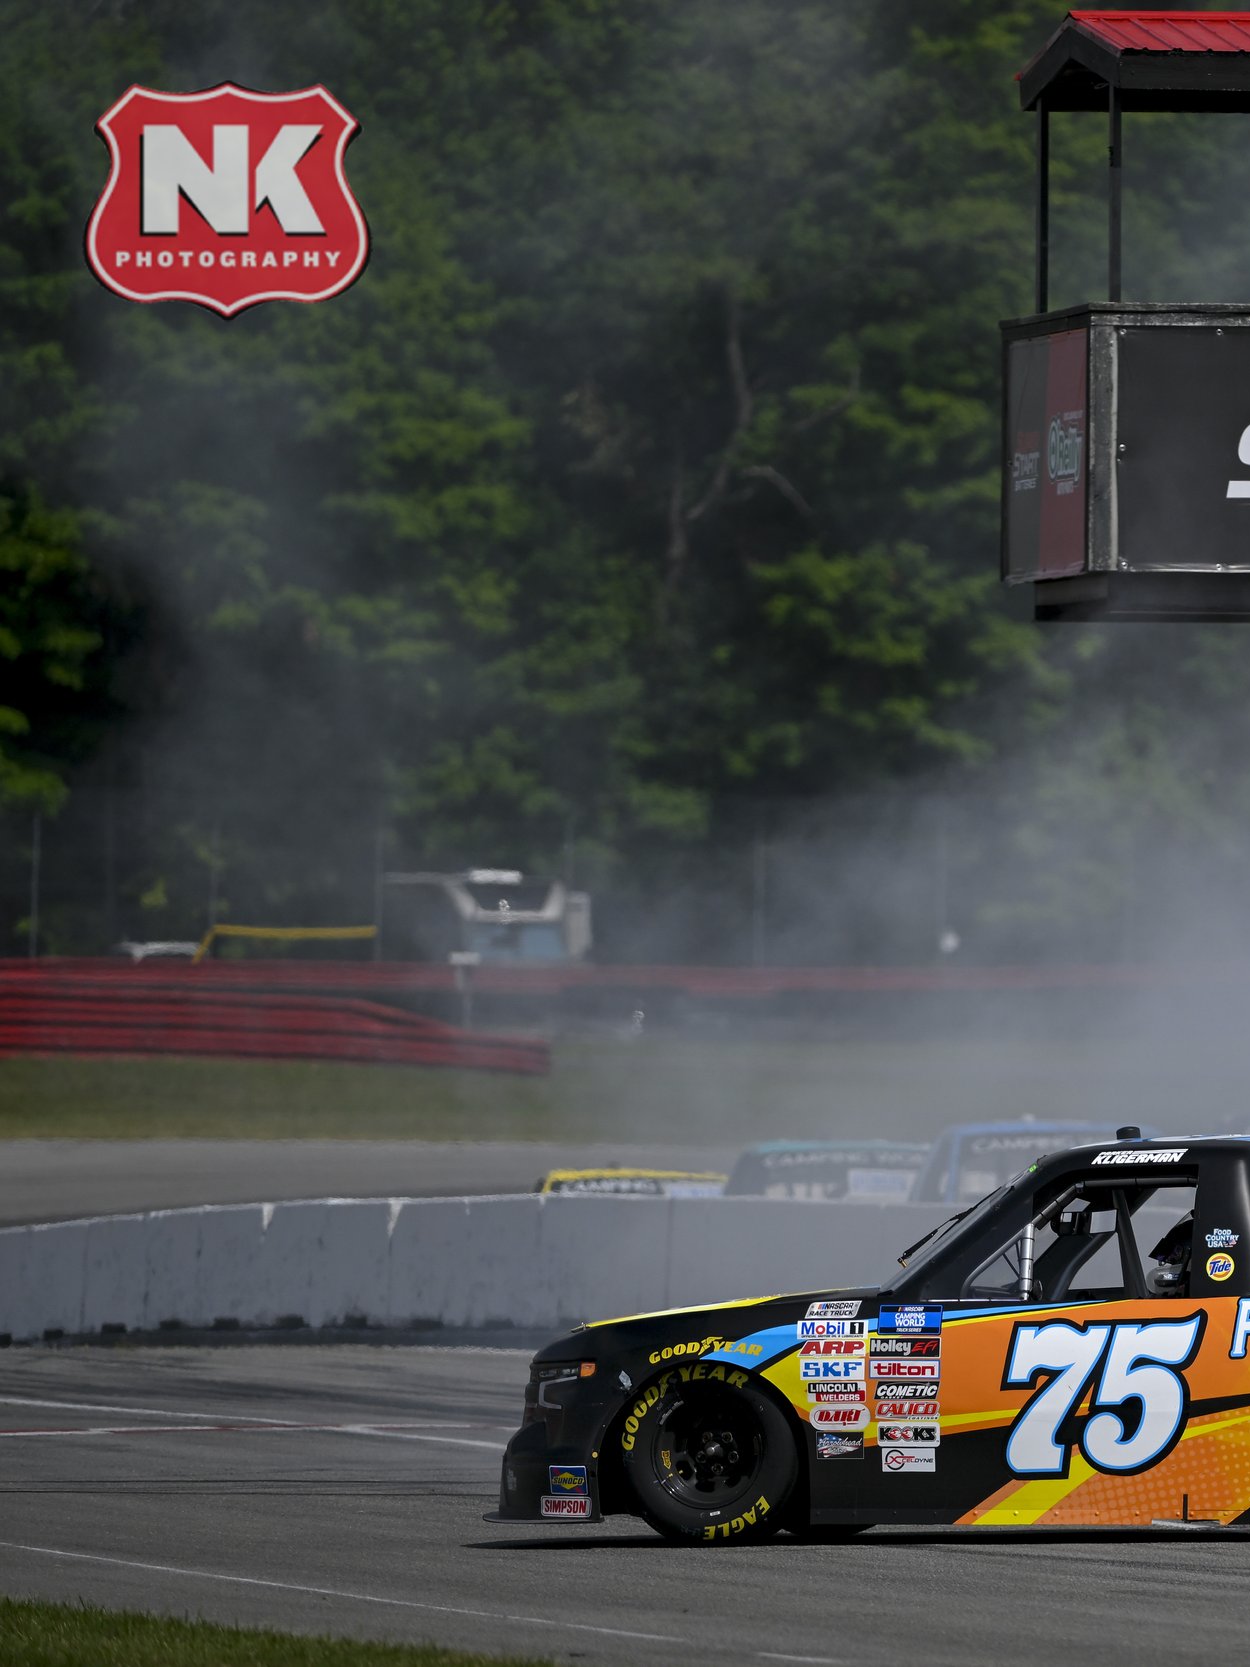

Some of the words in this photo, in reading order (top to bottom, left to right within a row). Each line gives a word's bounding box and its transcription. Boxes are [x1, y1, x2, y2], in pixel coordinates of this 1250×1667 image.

[1091, 1152, 1185, 1165] KLIGERMAN
[1207, 1240, 1224, 1248] USA
[1209, 1259, 1232, 1276] Tide
[801, 1322, 845, 1335] Mobil
[895, 1319, 926, 1327] WORLD
[648, 1336, 764, 1365] GOODYEAR
[800, 1340, 865, 1355] ARP
[871, 1340, 912, 1356] Holley
[803, 1362, 863, 1377] SKF
[873, 1363, 936, 1376] tilton
[810, 1383, 856, 1393] LINCOLN
[876, 1385, 938, 1397] COMETIC
[1002, 1309, 1206, 1477] 75
[621, 1363, 750, 1451] GOODYEAR
[877, 1403, 938, 1416] CALICO
[880, 1427, 937, 1442] KOOKS
[552, 1477, 584, 1486] SUNOCO
[544, 1499, 587, 1514] SIMPSON
[703, 1495, 771, 1540] EAGLE
